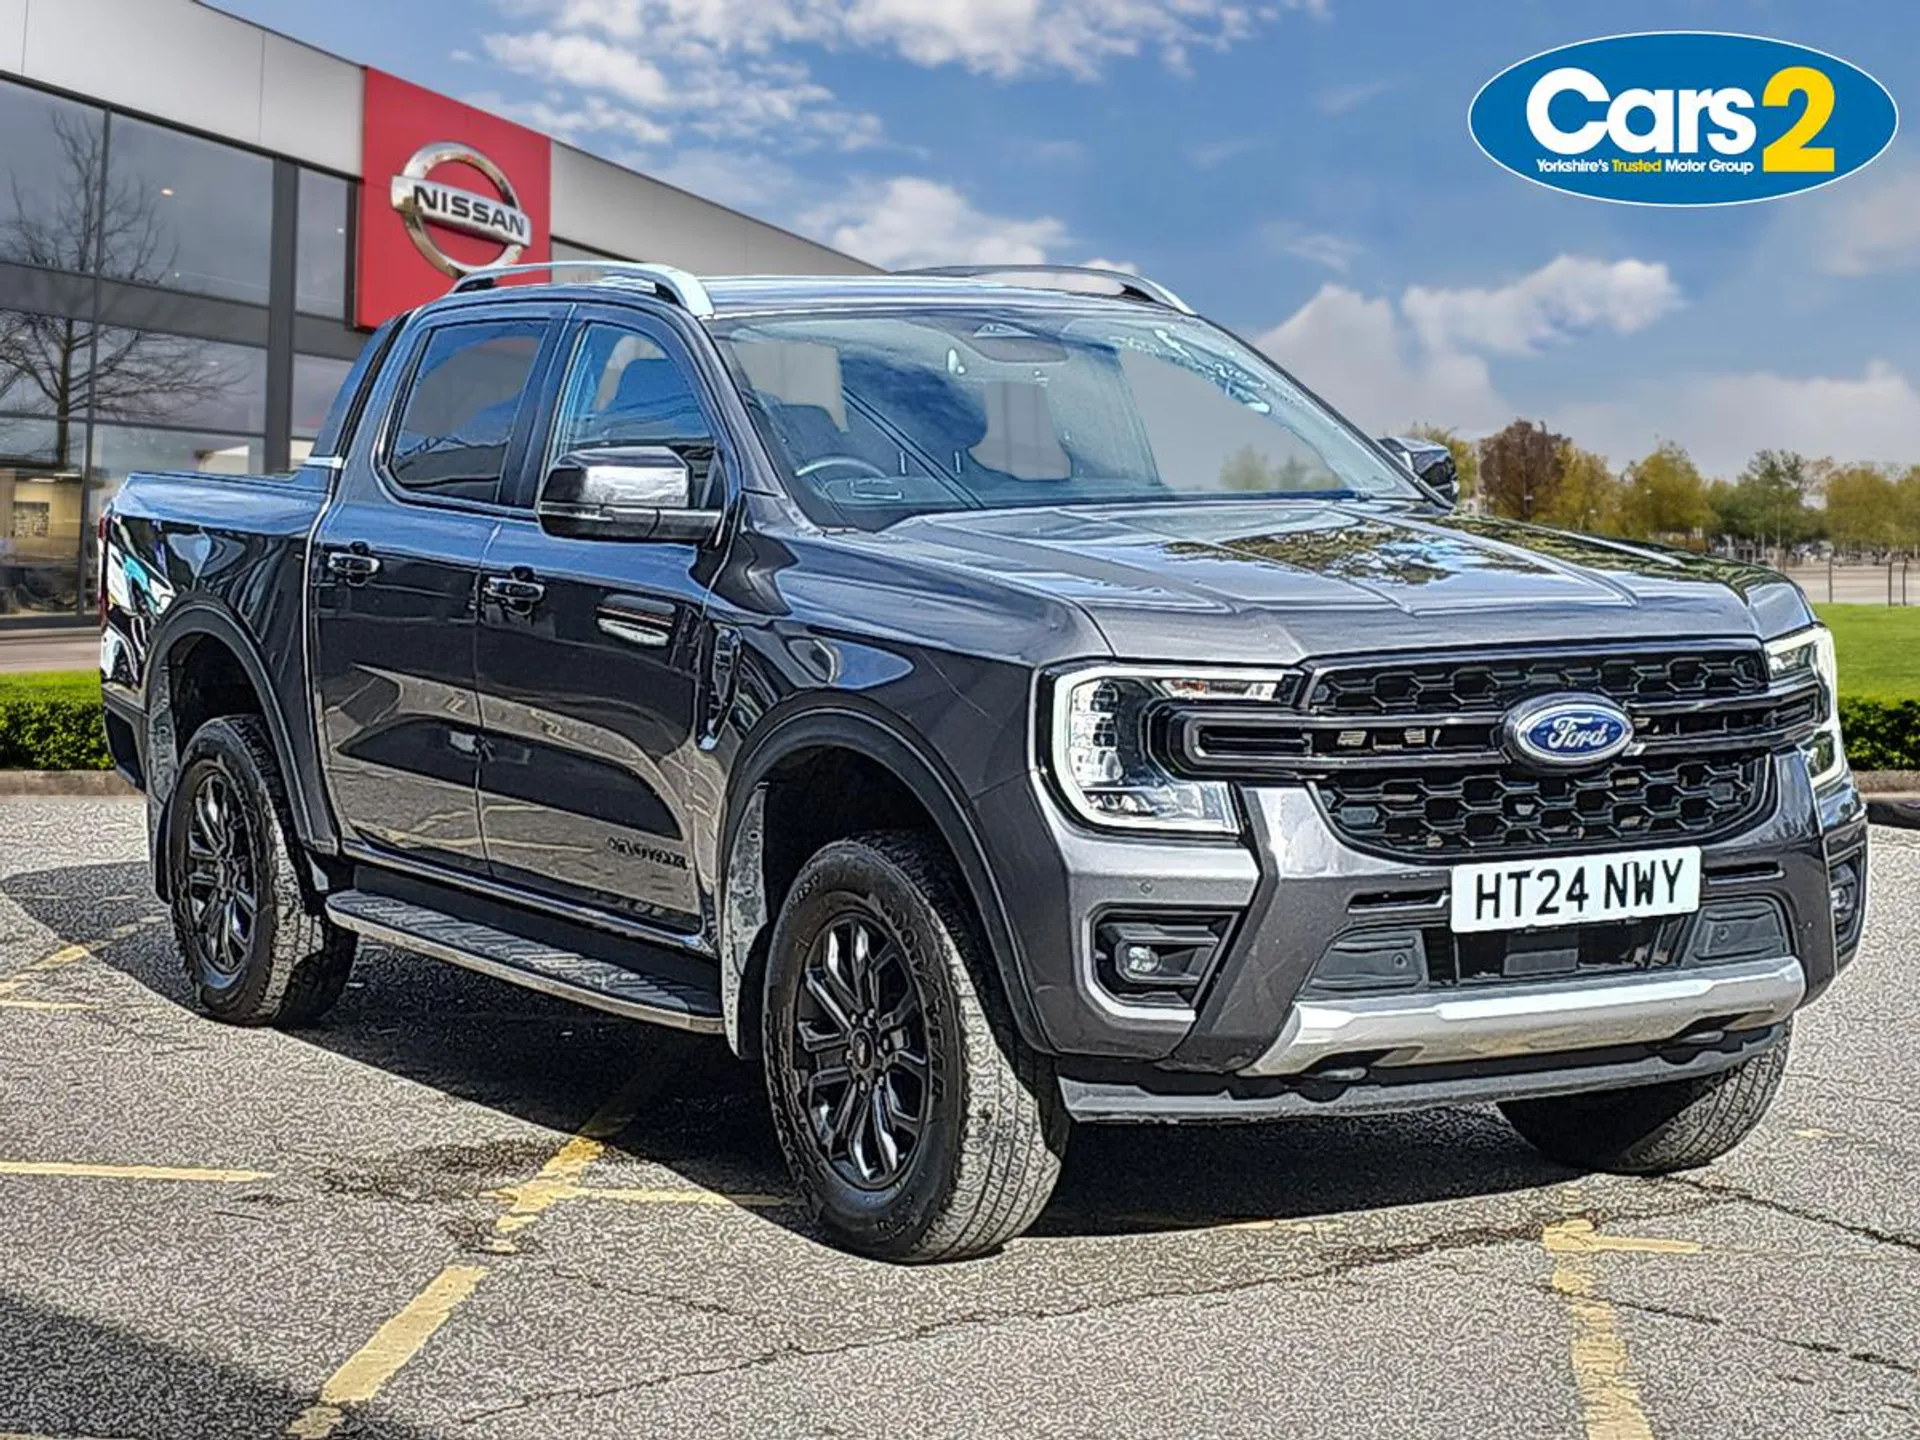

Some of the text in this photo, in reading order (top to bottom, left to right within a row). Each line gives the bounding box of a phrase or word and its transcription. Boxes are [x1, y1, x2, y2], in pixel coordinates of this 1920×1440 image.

[413, 185, 525, 237] NISSAN
[1549, 716, 1608, 749] Ford
[1474, 857, 1684, 920] HT24 NWY
